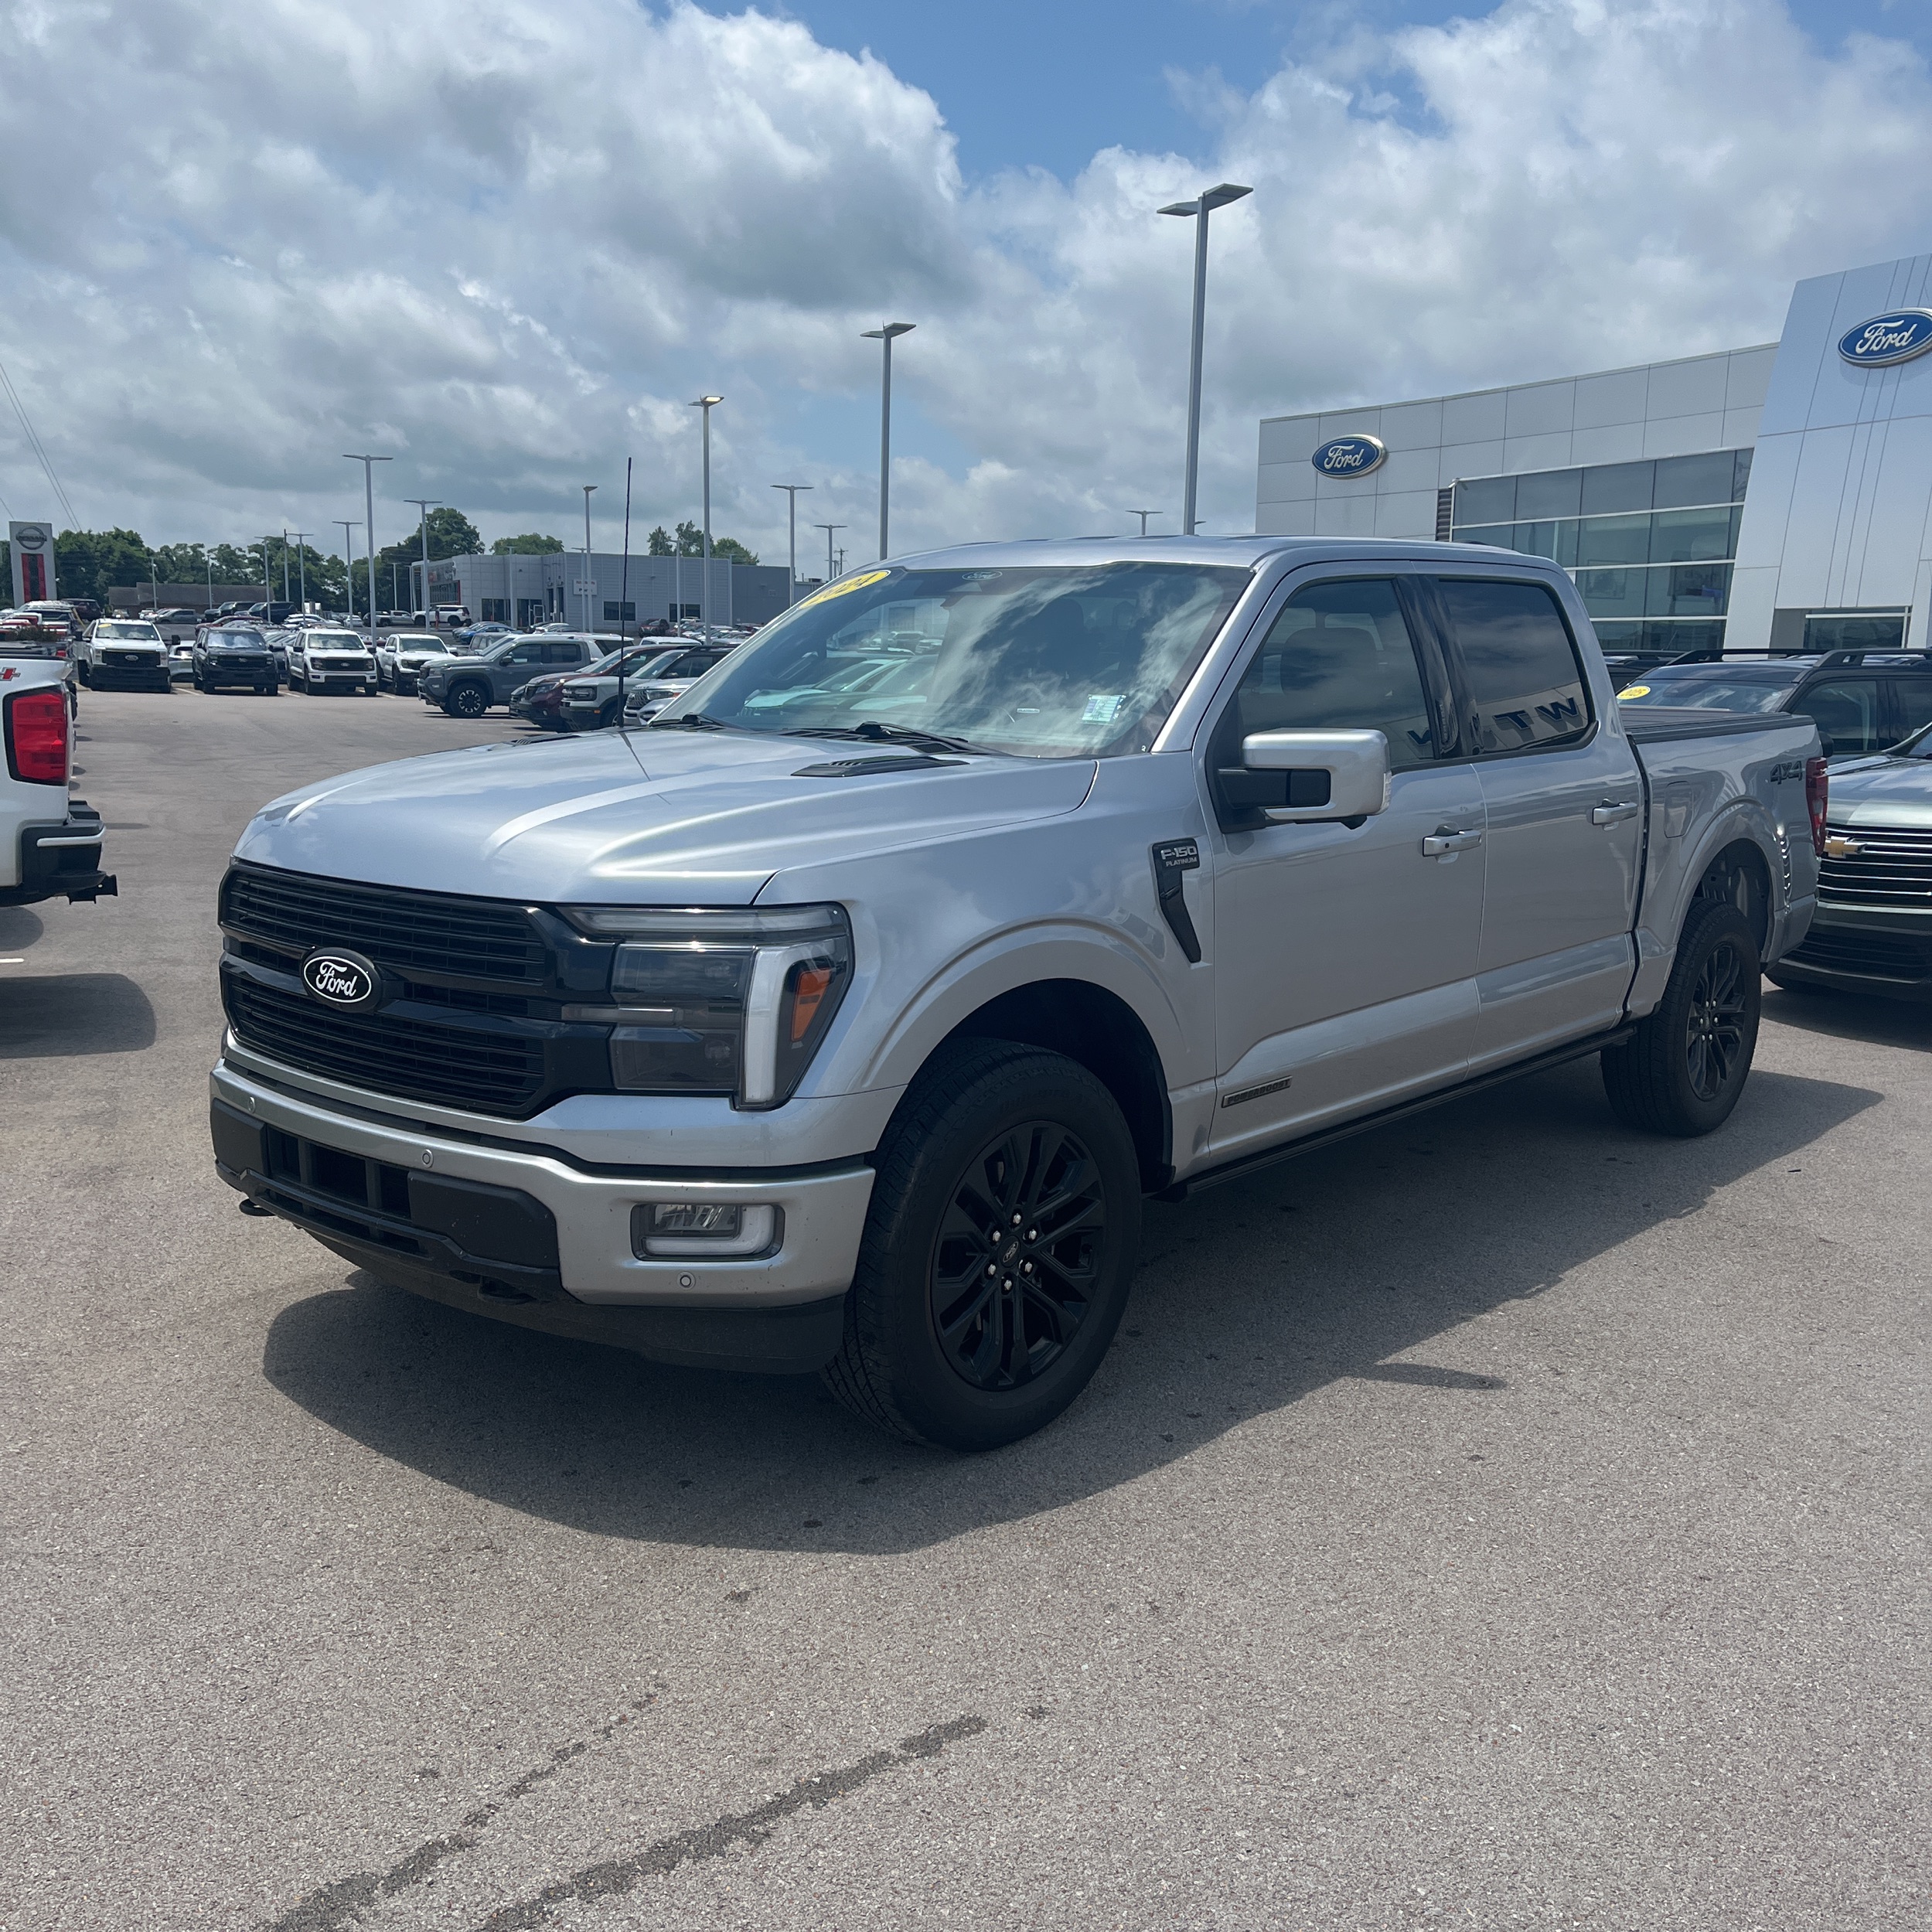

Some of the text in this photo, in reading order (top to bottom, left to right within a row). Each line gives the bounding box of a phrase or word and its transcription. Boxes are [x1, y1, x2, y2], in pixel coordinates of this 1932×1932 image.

[1855, 319, 1918, 354] Ford
[1324, 445, 1365, 469] Ford
[1160, 846, 1198, 860] F-150
[1165, 857, 1198, 867] PLATINUM
[315, 961, 357, 997] Ford
